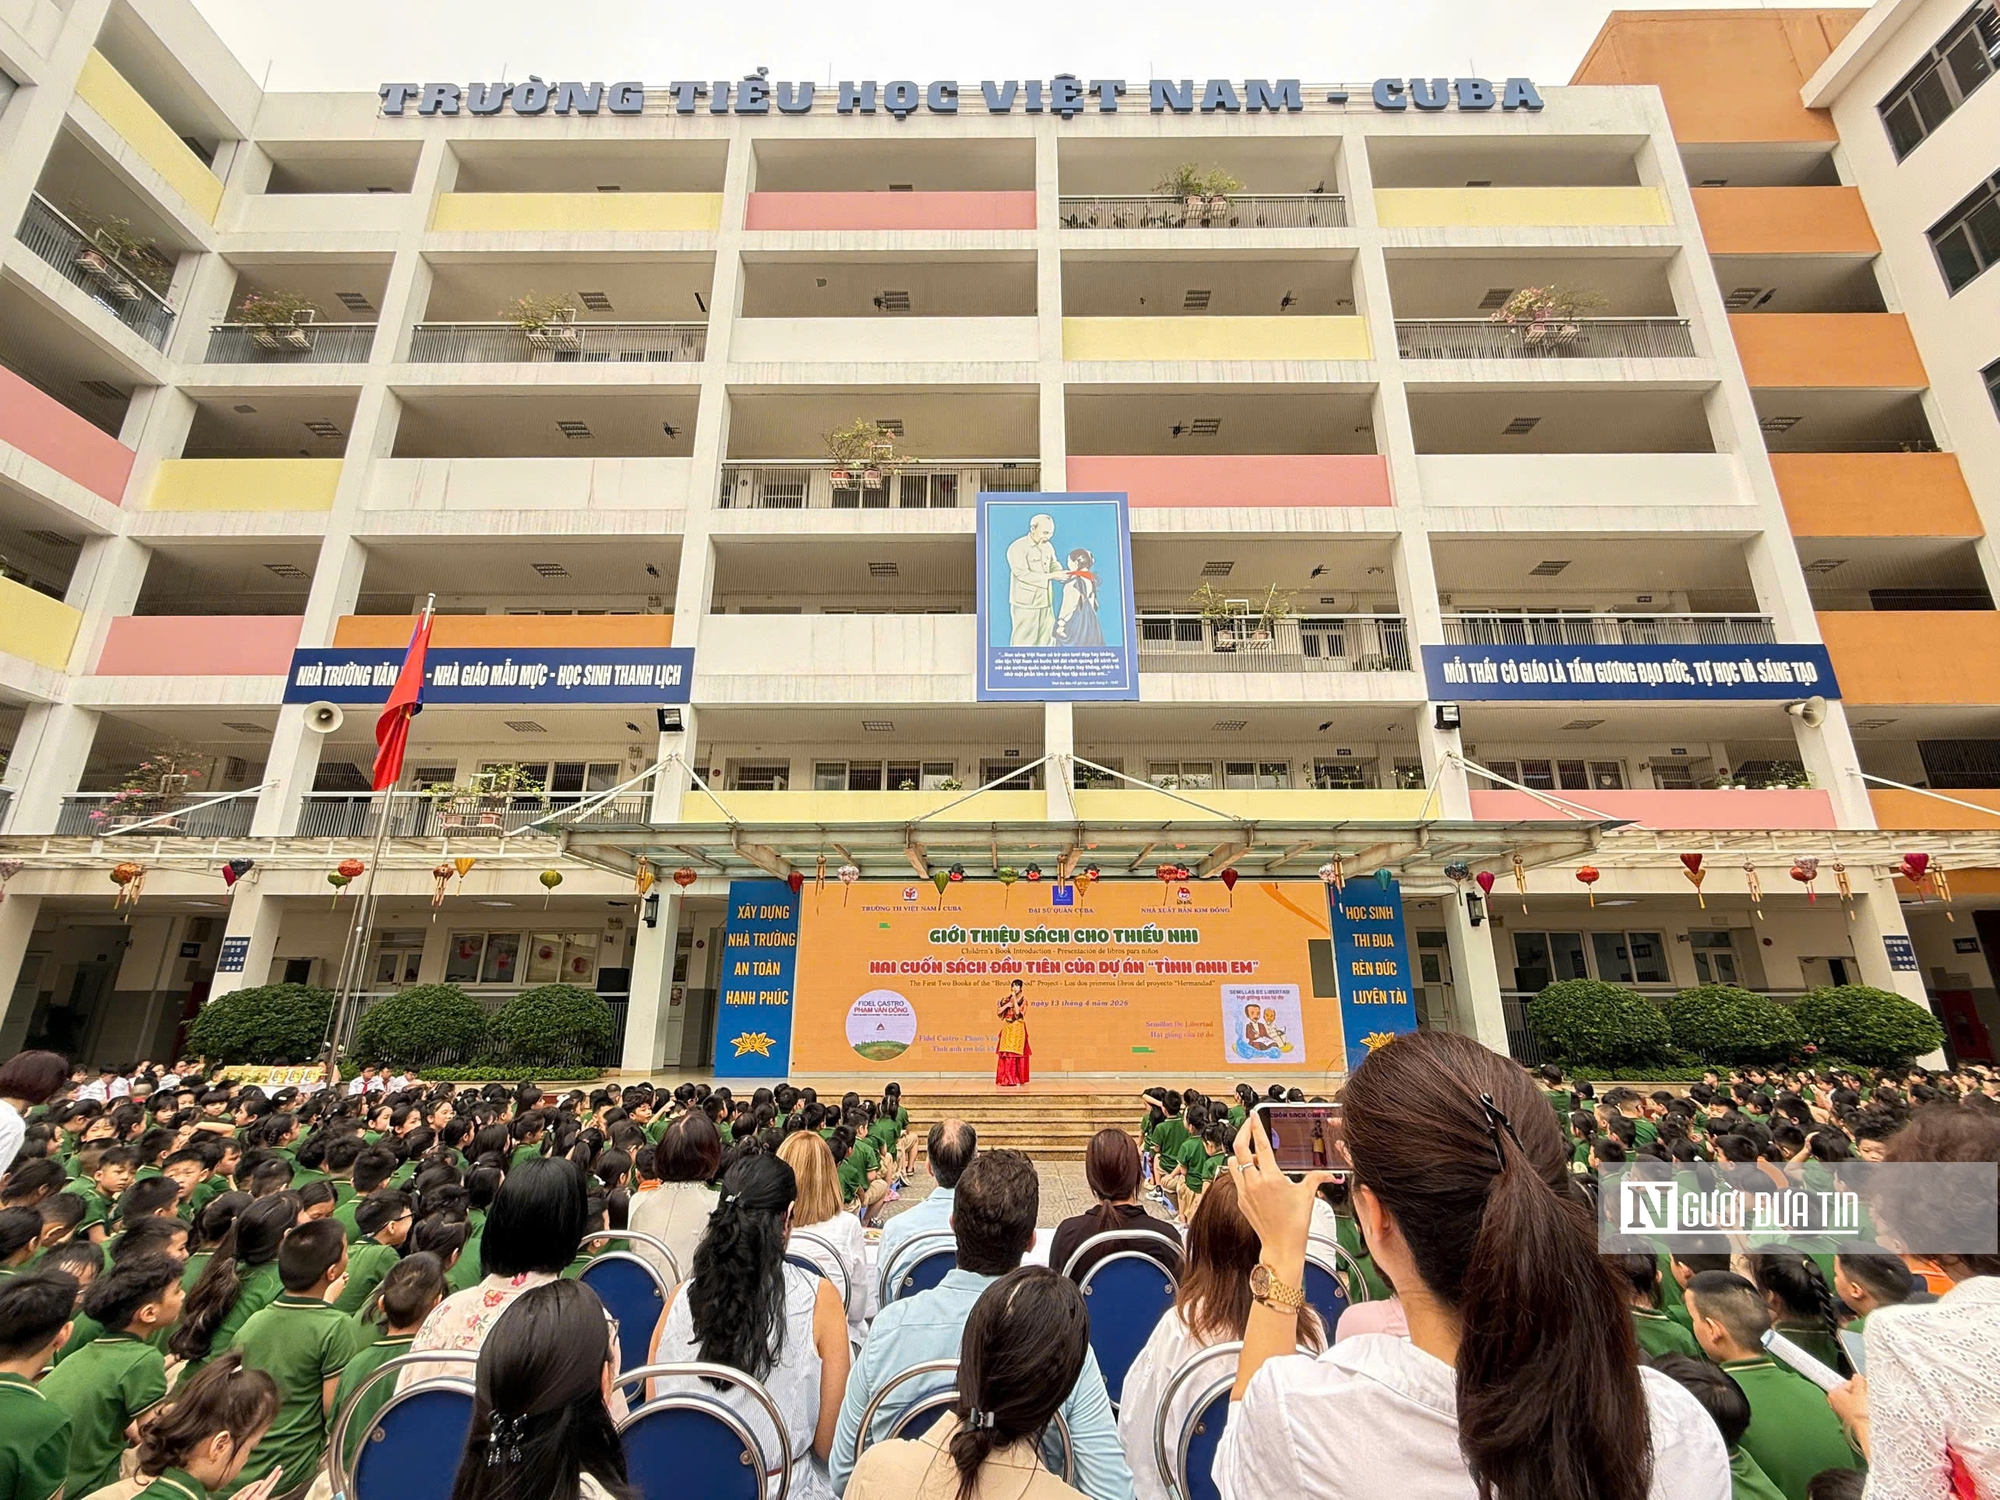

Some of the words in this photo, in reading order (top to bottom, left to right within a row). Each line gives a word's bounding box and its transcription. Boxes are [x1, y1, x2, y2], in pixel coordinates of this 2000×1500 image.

[378, 75, 645, 115] TRƯỜNG
[669, 66, 816, 115] TIỂU
[837, 80, 958, 121] HỌC
[981, 73, 1126, 119] VIỆT
[1148, 79, 1303, 112] NAM
[1371, 77, 1544, 112] CUBA
[296, 661, 323, 686] NHÀ
[322, 661, 372, 686] TRƯỜNG
[372, 661, 398, 686] VĂN
[433, 660, 460, 686] NHÀ
[461, 662, 489, 686] GIÁO
[490, 657, 520, 686] MẪU
[519, 662, 548, 689] MỰC
[556, 664, 583, 689] HỌC
[582, 664, 612, 686] SINH
[614, 664, 653, 686] THANH
[654, 664, 682, 689] LỊCH
[1443, 656, 1467, 684] MỖI
[1468, 657, 1498, 684] THẦY
[1500, 659, 1519, 684] CÔ
[1519, 658, 1549, 684] GIÁO
[1548, 657, 1567, 684] LÀ
[1566, 656, 1593, 684] TẤM
[1596, 660, 1638, 684] GƯƠNG
[1637, 661, 1664, 688] ĐẠO
[1663, 658, 1695, 686] ĐỨC,
[1695, 659, 1713, 687] TỰ
[1715, 661, 1741, 687] HỌC
[1738, 658, 1757, 684] VÀ
[1757, 657, 1792, 684] SÁNG
[1792, 661, 1818, 687] TẠO
[737, 904, 758, 919] XÂY
[760, 904, 790, 921] DỰNG
[1346, 906, 1369, 922] HỌC
[1370, 905, 1394, 919] SINH
[728, 930, 751, 947] NHÀ
[753, 931, 796, 947] TRƯỜNG
[929, 925, 966, 942] GIỚI
[970, 926, 1020, 947] THIỆU
[1024, 925, 1069, 942] SÁCH
[1074, 930, 1109, 942] CHO
[1113, 924, 1164, 942] THIẾU
[1168, 930, 1198, 942] NHI
[1352, 933, 1370, 947] THI
[1371, 933, 1394, 947] ĐUA
[734, 963, 751, 976] AN
[752, 959, 781, 976] TOÀN
[870, 961, 896, 974] HAI
[900, 956, 942, 974] CUỐN
[946, 957, 987, 974] SÁCH
[990, 956, 1022, 974] ĐẦU
[1026, 957, 1061, 974] TIÊN
[1064, 958, 1095, 974] CỦA
[1100, 960, 1121, 977] DỰ
[1123, 958, 1144, 974] ÁN
[1196, 961, 1227, 974] ANH
[1352, 959, 1374, 976] RÈN
[1375, 959, 1397, 976] ĐỨC
[1037, 980, 1059, 988] Project
[1089, 980, 1115, 988] primeros
[1147, 980, 1173, 988] proyecto
[726, 991, 758, 1007] HẠNH
[759, 988, 789, 1005] PHÚC
[1389, 986, 1407, 1004] TÀI
[1062, 1000, 1083, 1008] tháng
